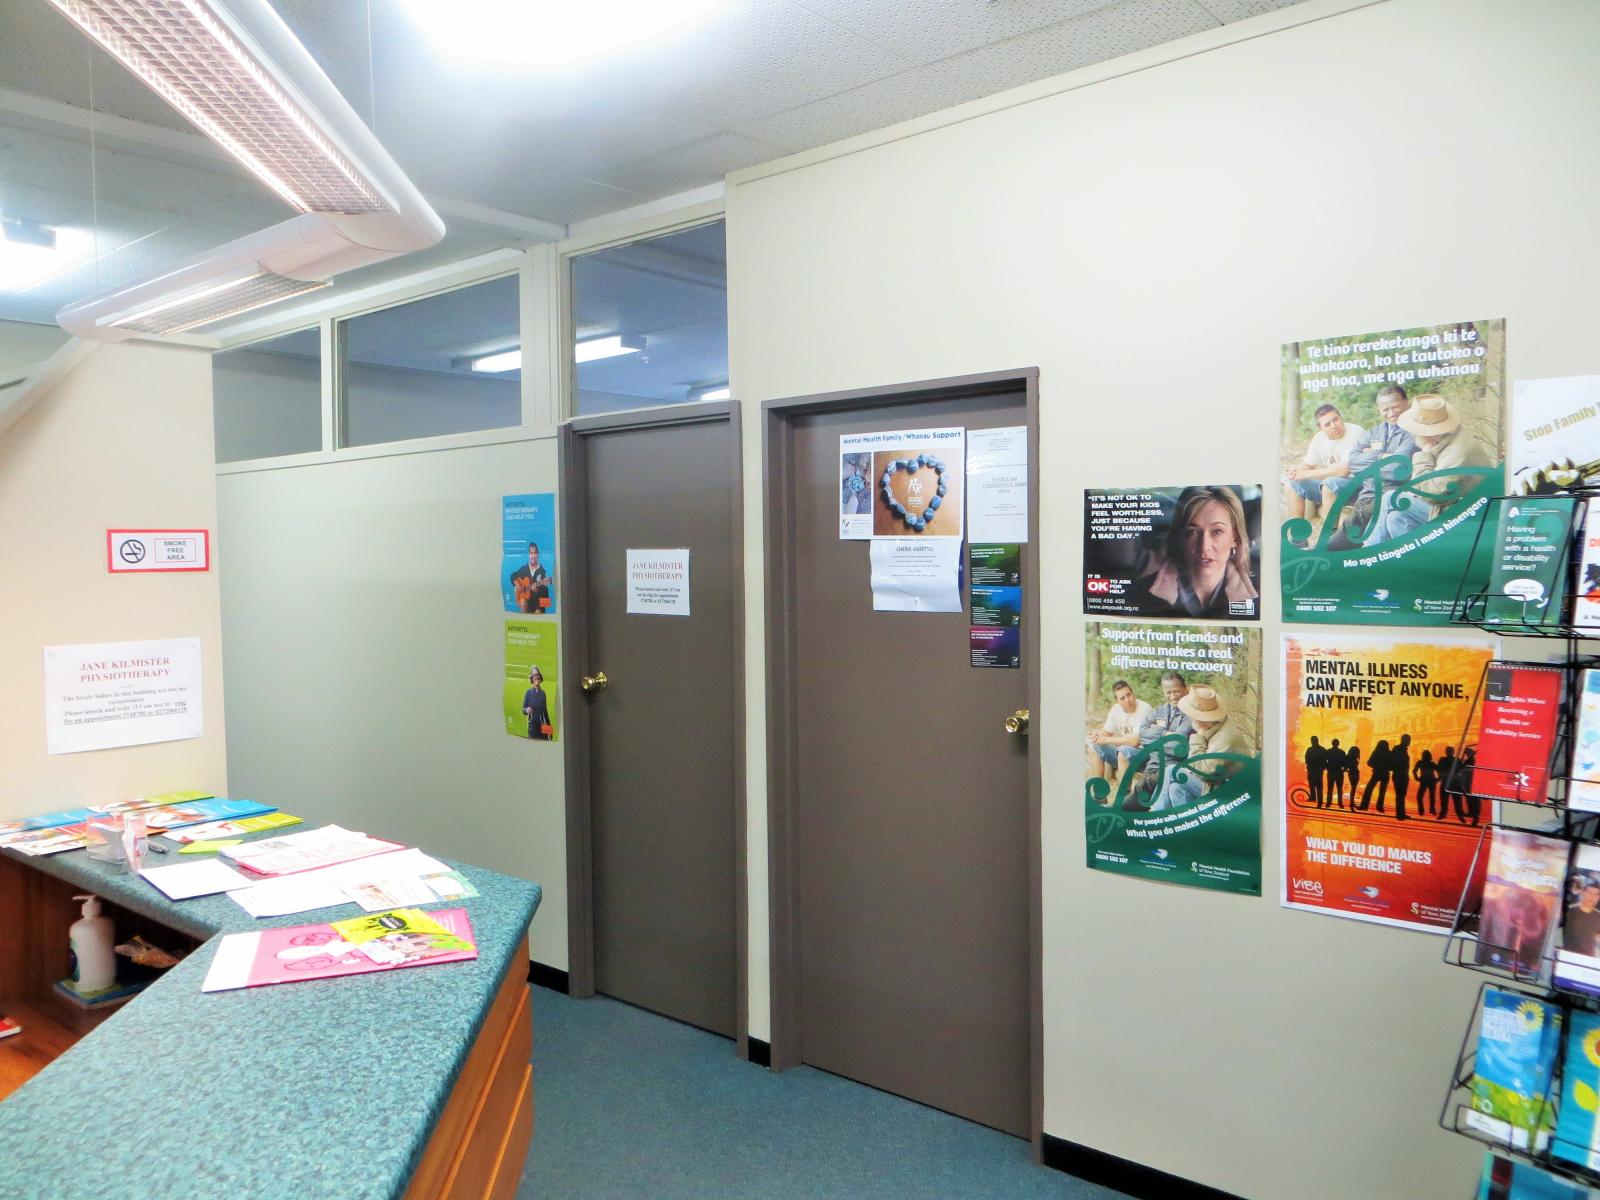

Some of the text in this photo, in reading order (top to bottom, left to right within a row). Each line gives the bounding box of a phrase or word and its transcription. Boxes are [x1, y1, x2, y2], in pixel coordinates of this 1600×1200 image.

[1306, 329, 1476, 358] Te tino rereketanga ki te
[1300, 347, 1485, 374] whakaora, ko te tautoko o
[1304, 362, 1480, 392] nga hoa, me nga whānau
[1524, 406, 1597, 442] Stop Family
[1343, 496, 1488, 568] Mo nga tāngata i mate hinengaro
[1507, 526, 1536, 535] Having
[1514, 555, 1550, 563] disability
[1088, 581, 1109, 592] OK
[1102, 628, 1244, 645] Support from friends and
[1111, 643, 1232, 659] whānau makes a real
[80, 657, 170, 671] JANE KILMISTER
[1111, 655, 1233, 676] difference to recovery
[1306, 659, 1428, 679] MENTAL ILLNESS
[80, 668, 169, 682] PHYSIOTHERAPY
[1306, 676, 1470, 702] CAN AFFECT ANYONE,
[1306, 693, 1372, 711] ANYTIME
[1485, 728, 1518, 738] Disability
[1126, 792, 1251, 839] What you do makes the difference
[1145, 817, 1164, 826] people
[1177, 806, 1199, 819] mental
[1306, 836, 1432, 865] WHAT YOU DO MAKES
[1306, 850, 1402, 875] THE DIFFERENCE
